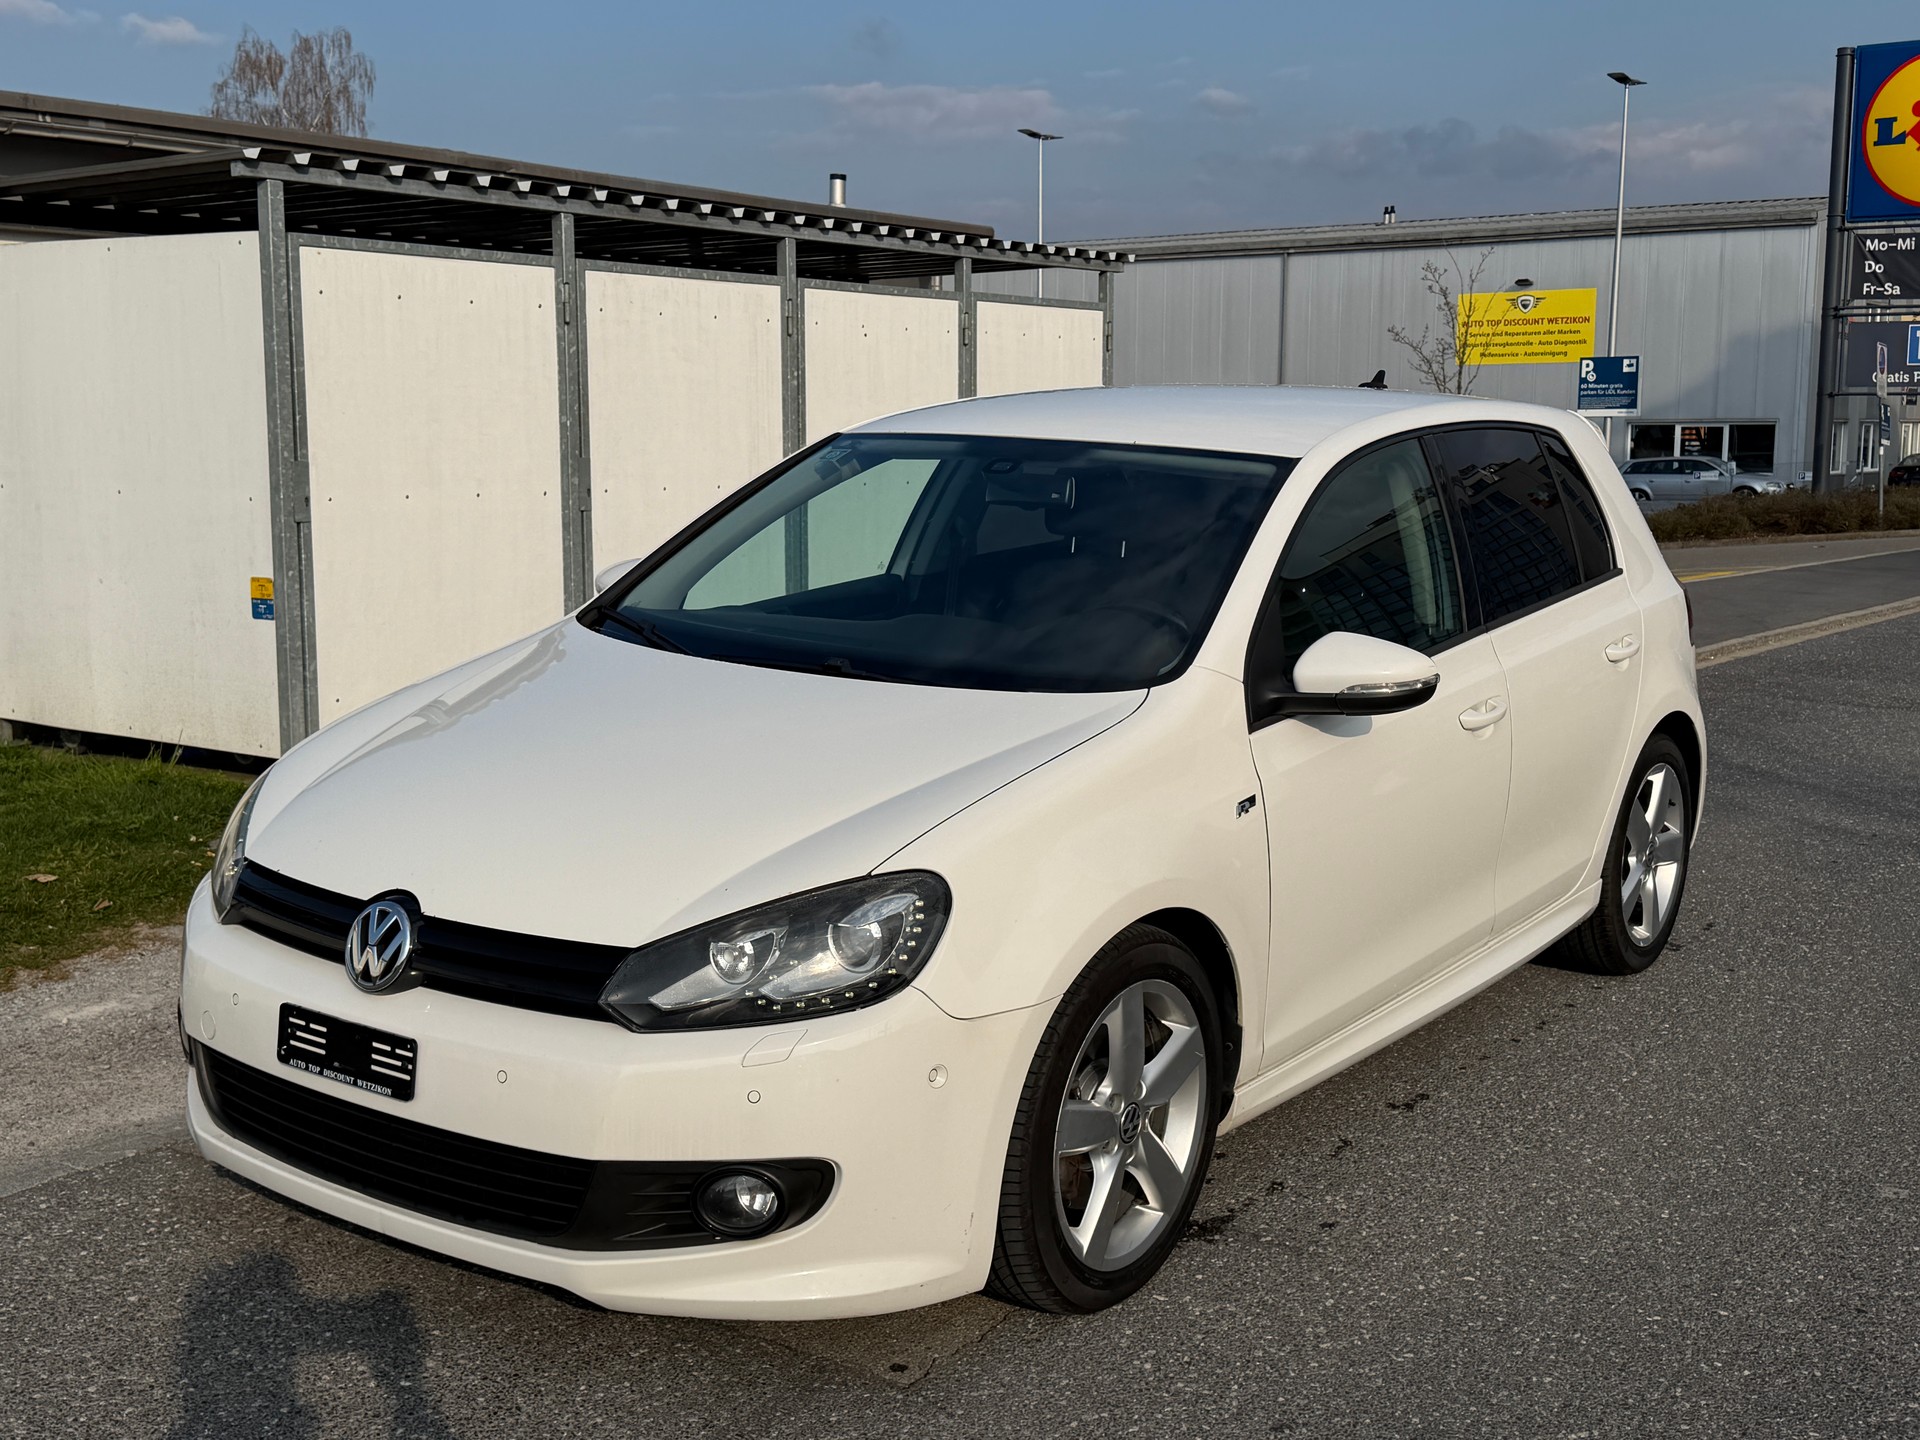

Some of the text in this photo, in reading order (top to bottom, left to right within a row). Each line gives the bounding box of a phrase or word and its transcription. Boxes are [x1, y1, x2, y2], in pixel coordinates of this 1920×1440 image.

[1864, 260, 1885, 273] Do
[1486, 319, 1502, 328] TOP
[1504, 317, 1546, 327] DISCOUNT
[1547, 316, 1591, 325] WETZIKON
[1505, 330, 1542, 338] Reparaturen
[1557, 328, 1582, 336] Marken
[1463, 340, 1533, 348] otorfahrzeugkontrolle
[1538, 339, 1553, 347] Auto
[1554, 338, 1588, 347] Diagnostik
[1523, 350, 1568, 358] Autoreinigung
[1872, 371, 1910, 383] atis
[289, 1058, 392, 1096] AUTO TOP DISCOUNT WETZIKON
